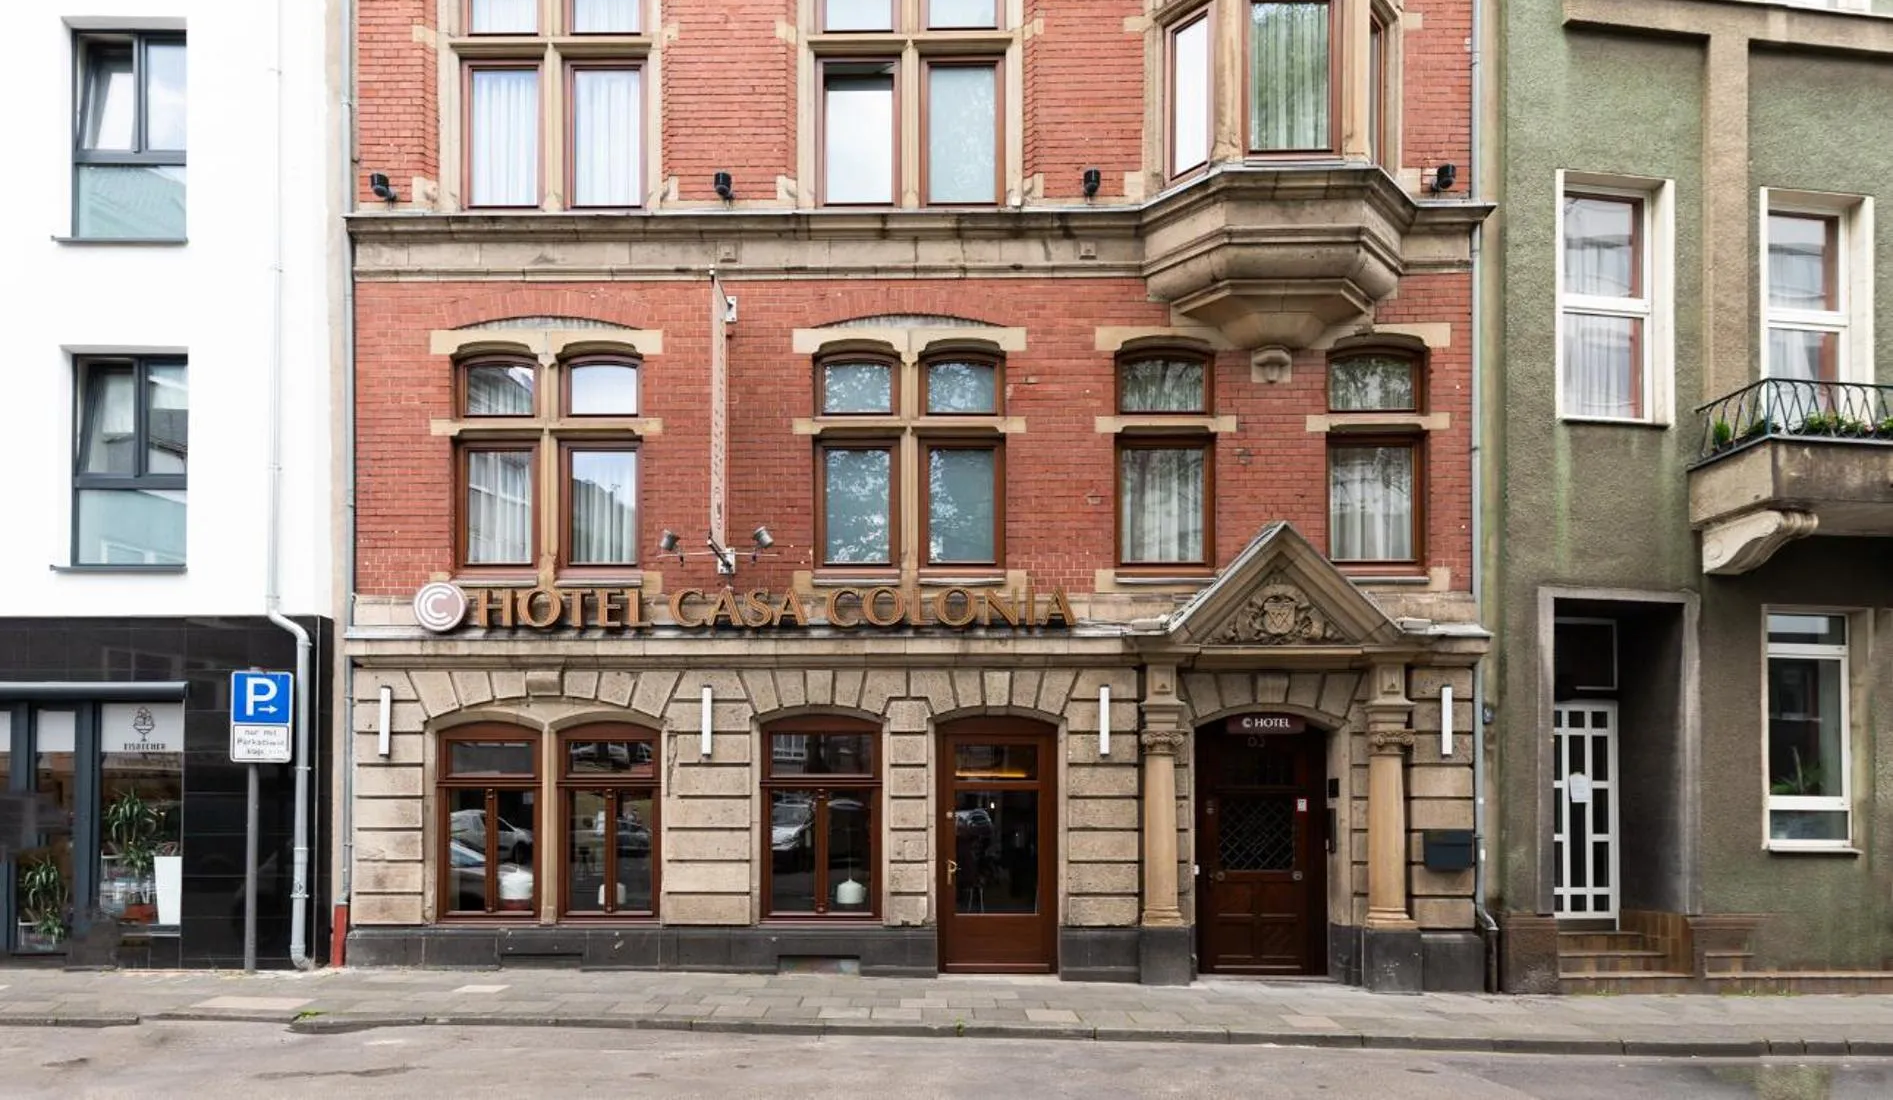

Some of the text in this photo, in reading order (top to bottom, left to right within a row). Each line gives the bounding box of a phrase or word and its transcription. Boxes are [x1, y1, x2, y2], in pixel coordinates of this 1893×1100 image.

[476, 587, 652, 628] HOTEL
[669, 587, 809, 627] CASA
[825, 587, 1076, 628] COLONIA
[246, 677, 277, 716] P
[1254, 718, 1290, 728] HOTEL
